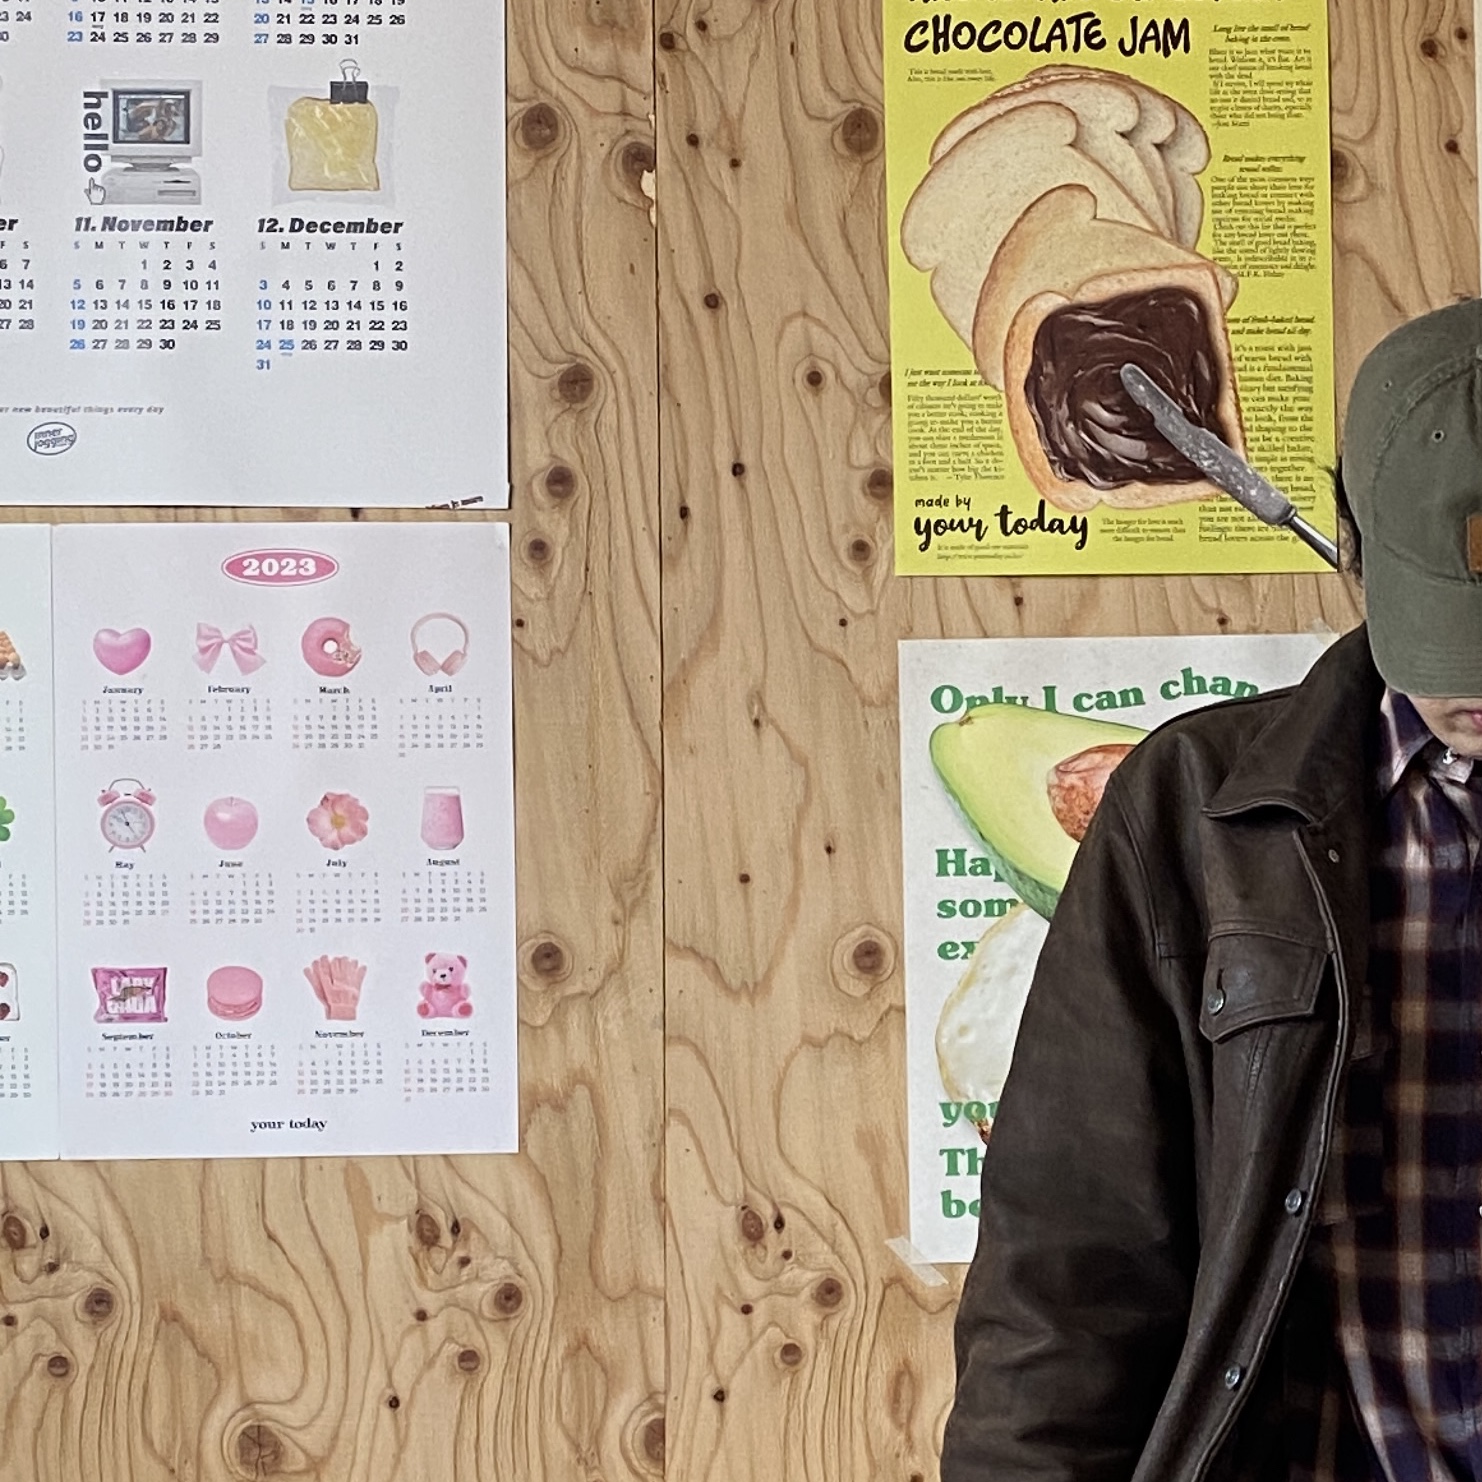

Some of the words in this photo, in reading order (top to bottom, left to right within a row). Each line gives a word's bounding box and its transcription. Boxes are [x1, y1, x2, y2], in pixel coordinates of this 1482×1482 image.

[253, 13, 270, 24] 20
[276, 13, 291, 25] 21
[298, 13, 315, 25] 22
[321, 13, 338, 25] 23
[344, 13, 360, 25] 24
[366, 14, 383, 26] 25
[389, 14, 406, 25] 26
[903, 10, 1107, 55] CHOCOLATE
[1117, 15, 1191, 59] JAM
[82, 90, 110, 174] hello
[74, 215, 97, 233] 11.
[100, 215, 214, 233] November
[257, 216, 285, 234] 12.
[288, 216, 405, 235] December
[373, 260, 379, 272] 1
[395, 260, 404, 272] 2
[259, 279, 268, 291] 3
[281, 279, 291, 291] 4
[304, 279, 314, 291] 5
[327, 279, 336, 292] 6
[349, 279, 359, 291] 7
[372, 279, 382, 292] 8
[395, 280, 404, 292] 9
[70, 299, 86, 310] 12
[92, 299, 108, 311] 13
[115, 299, 130, 310] 14
[137, 299, 153, 310] 15
[159, 299, 176, 311] 16
[182, 299, 199, 311] 17
[205, 299, 222, 311] 18
[257, 299, 272, 310] 10
[279, 299, 293, 311] 11
[302, 299, 317, 311] 12
[324, 300, 340, 311] 13
[346, 299, 362, 311] 14
[369, 300, 385, 311] 15
[392, 300, 408, 312] 16
[257, 319, 272, 331] 17
[279, 319, 295, 331] 18
[302, 319, 317, 331] 19
[323, 319, 340, 331] 20
[346, 319, 361, 331] 21
[368, 319, 385, 331] 22
[391, 319, 408, 332] 23
[256, 339, 272, 350] 24
[279, 339, 295, 351] 25
[301, 339, 318, 351] 26
[323, 339, 340, 351] 27
[346, 339, 363, 351] 28
[368, 339, 385, 352] 29
[391, 339, 408, 352] 30
[256, 359, 271, 371] 31
[914, 494, 950, 508] made
[955, 494, 972, 512] by
[914, 516, 988, 552] your
[994, 499, 1088, 551] today
[241, 557, 317, 578] 2023
[319, 685, 351, 695] March
[428, 684, 453, 695] April
[1042, 685, 1058, 713] I
[1072, 686, 1146, 713] can
[326, 858, 348, 868] July
[250, 1120, 285, 1133] your
[289, 1116, 327, 1132] today
